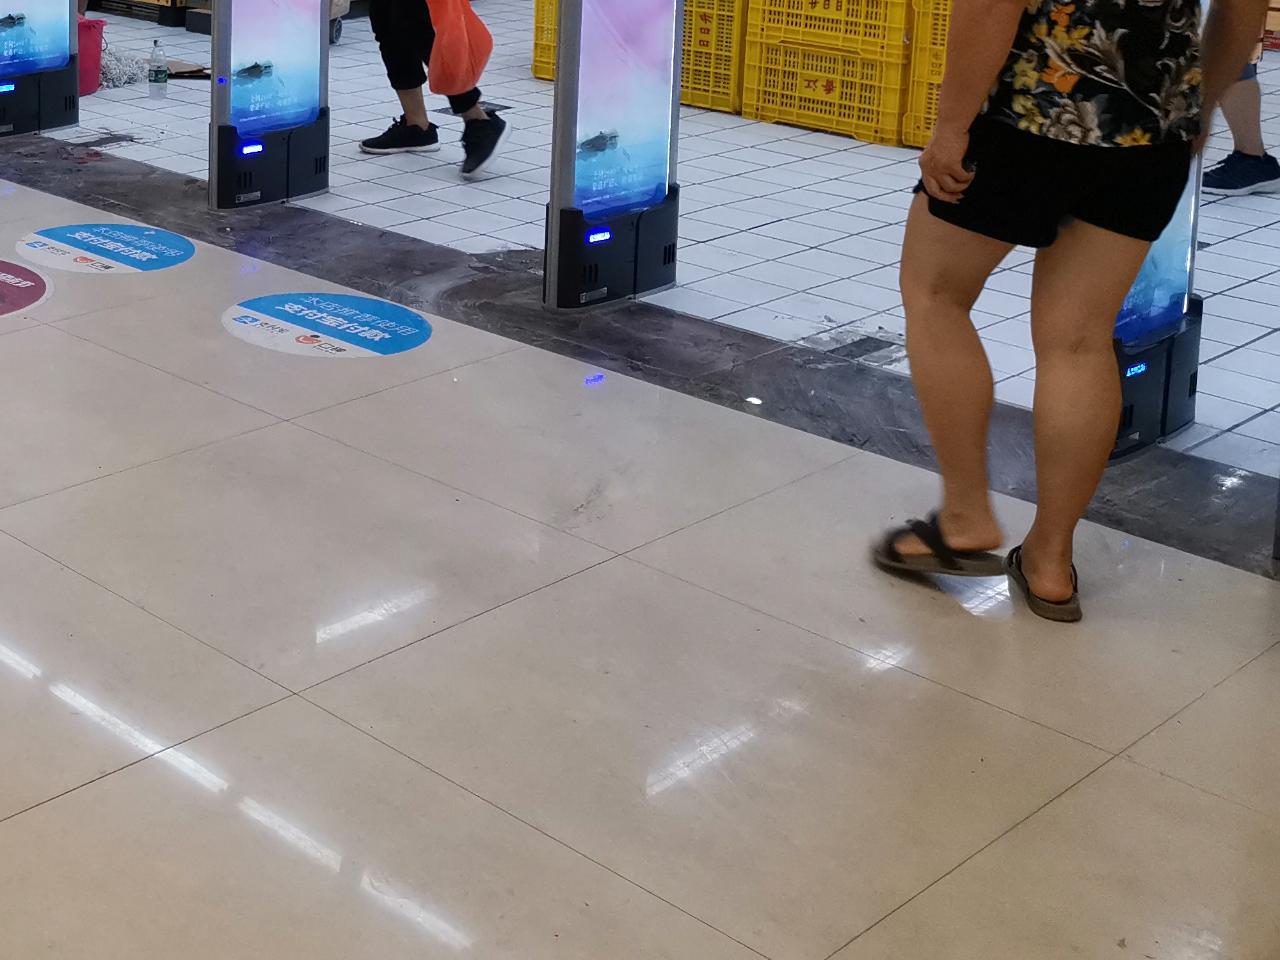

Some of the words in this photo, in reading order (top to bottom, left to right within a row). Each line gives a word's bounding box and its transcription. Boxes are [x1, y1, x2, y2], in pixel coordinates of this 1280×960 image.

[66, 231, 159, 262] 支付宝付款
[275, 302, 392, 342] 支付宝付款
